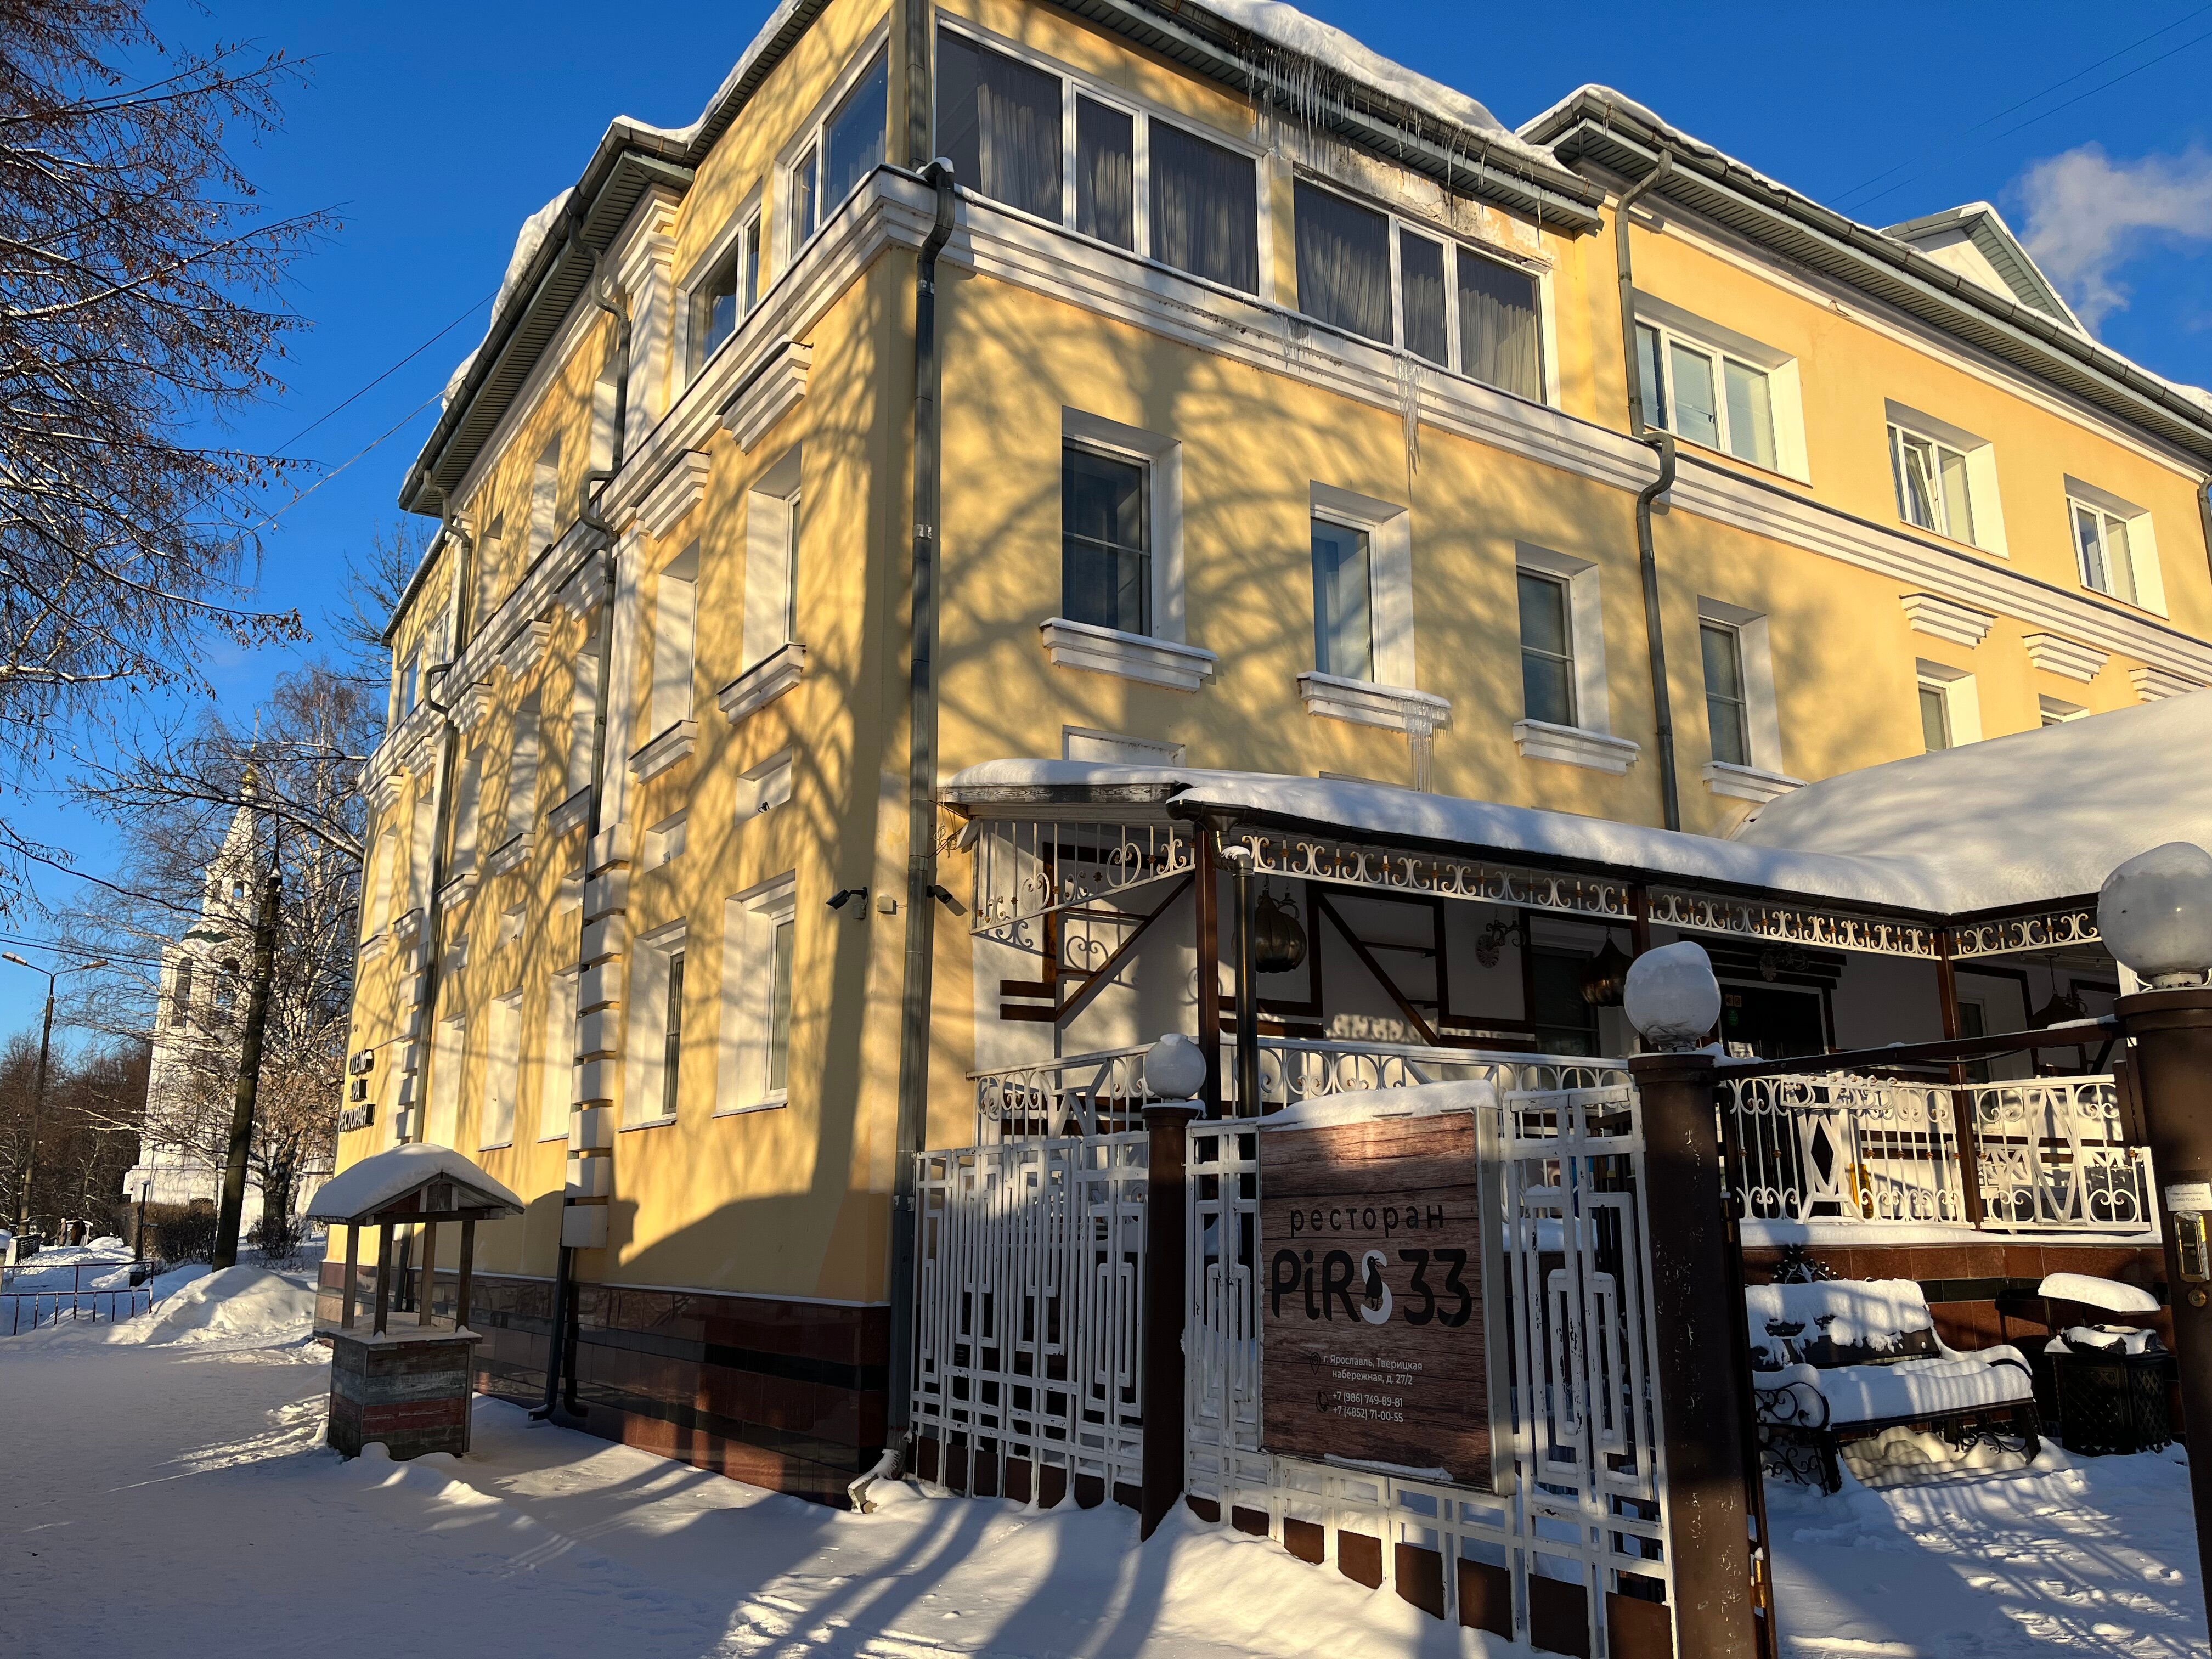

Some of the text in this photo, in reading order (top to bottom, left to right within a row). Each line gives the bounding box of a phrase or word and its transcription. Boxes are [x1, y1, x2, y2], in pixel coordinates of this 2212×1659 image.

[338, 1104, 370, 1132] РЕСТОРАН
[1291, 1205, 1443, 1238] ресторан
[1398, 1249, 1472, 1328] 33
[1330, 1355, 1375, 1368] Ярославль,
[1376, 1358, 1423, 1371] Тверицкая
[1332, 1369, 1413, 1386] набережная, д. 27/2
[1333, 1391, 1403, 1408] +7 (986) 749-89-81
[1333, 1406, 1403, 1423] +7 (4852) 71-00-55
